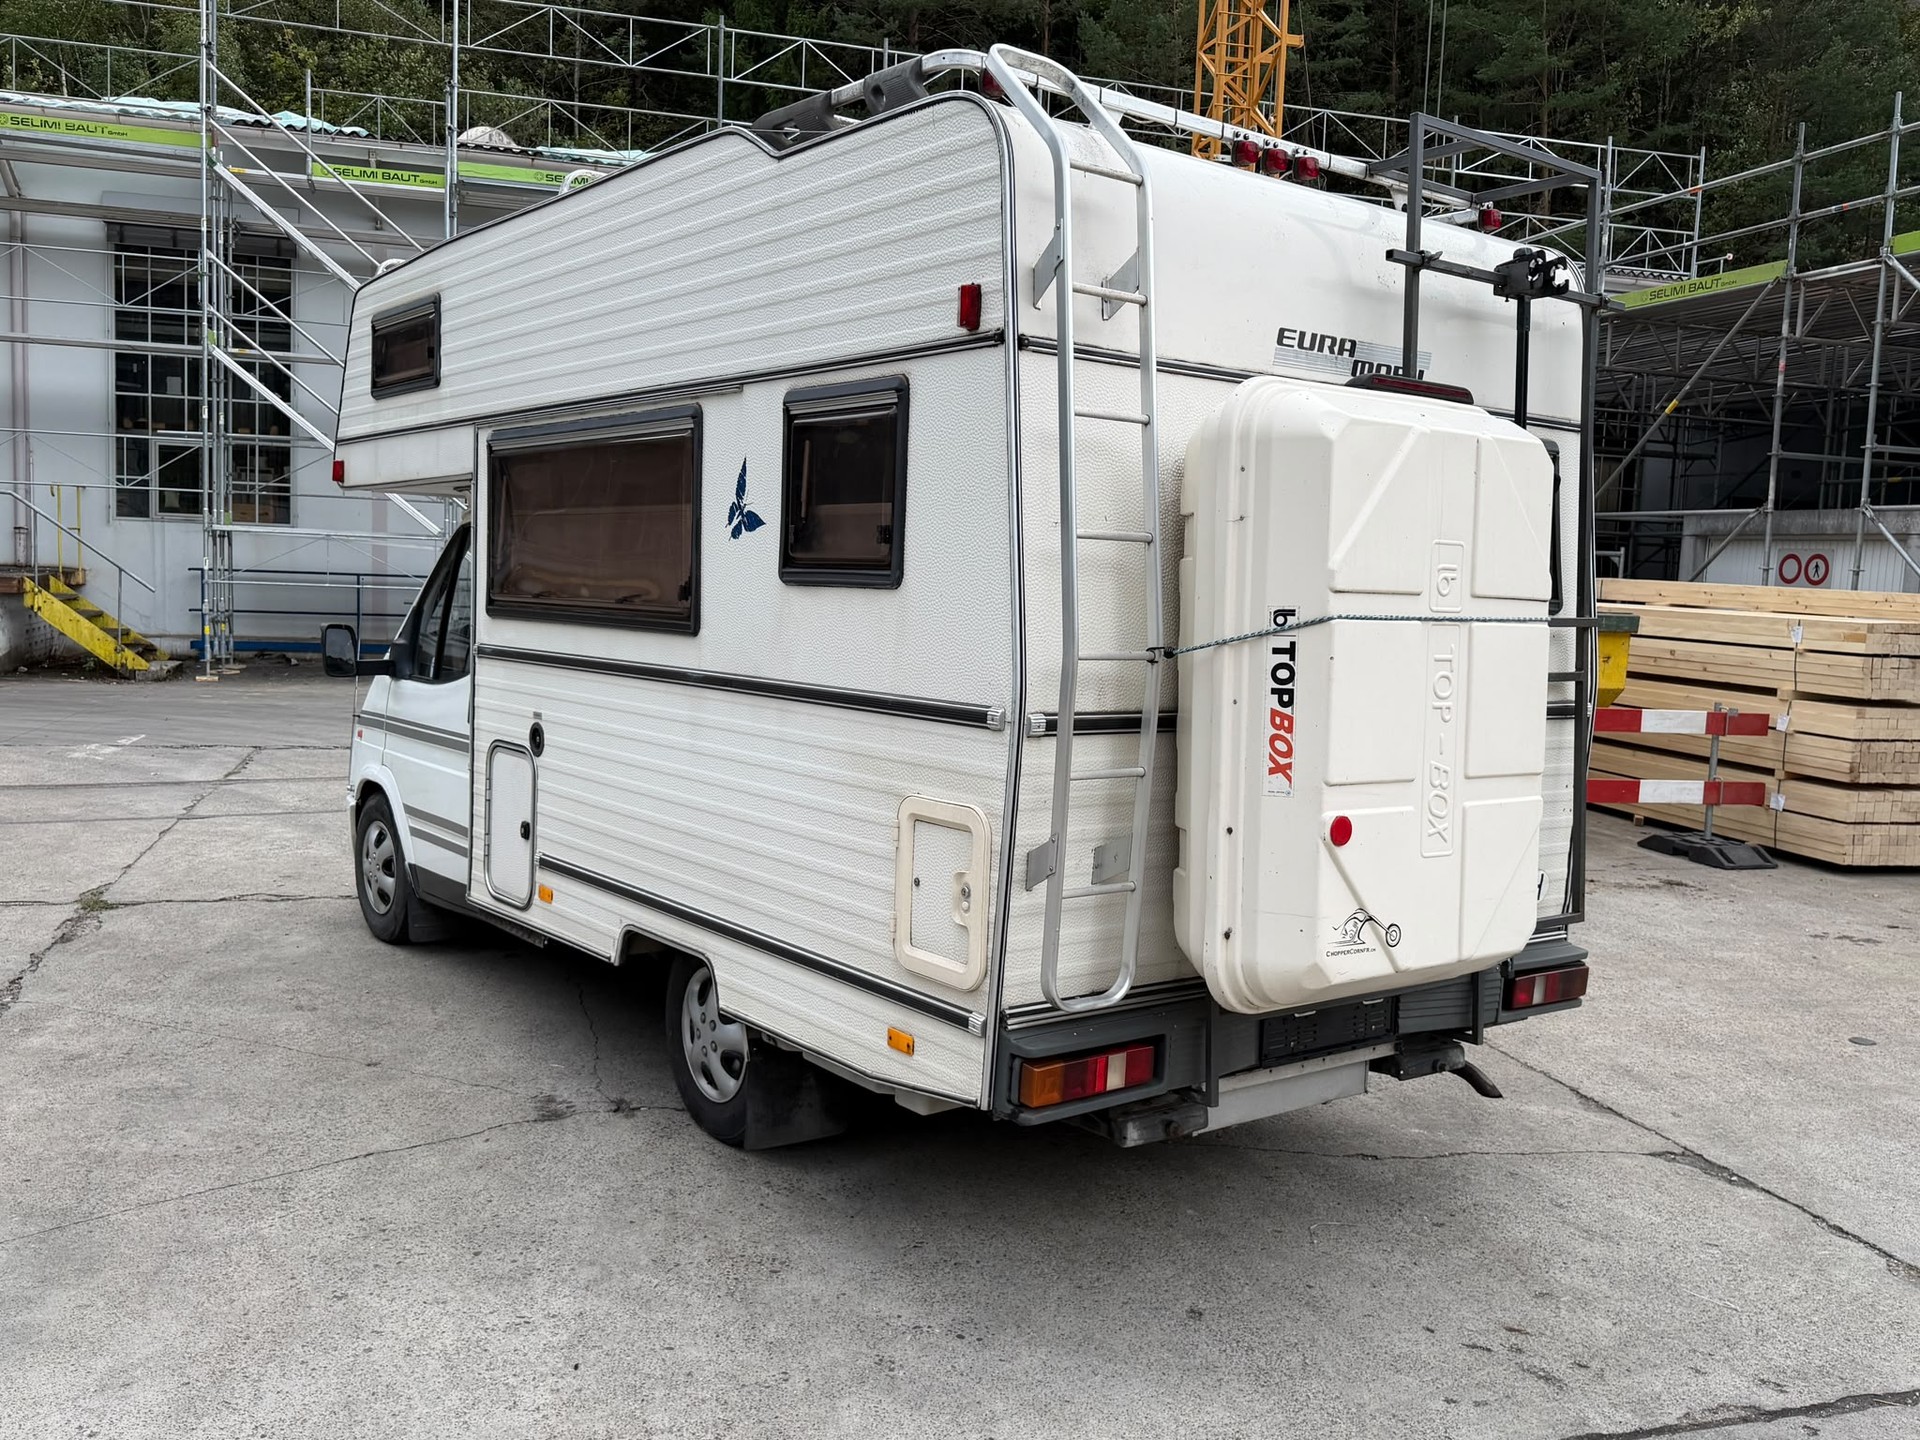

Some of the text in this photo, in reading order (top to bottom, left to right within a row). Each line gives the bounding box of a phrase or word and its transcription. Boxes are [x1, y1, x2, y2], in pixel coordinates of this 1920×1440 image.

[10, 116, 60, 130] SELIMI
[65, 122, 108, 134] BAUT
[332, 167, 378, 180] SELIMI
[382, 171, 420, 183] BAUT
[1649, 284, 1686, 300] SELIMI
[1688, 277, 1721, 293] BAUT
[1276, 327, 1357, 358] EURA
[1267, 641, 1296, 787] TOPBOX
